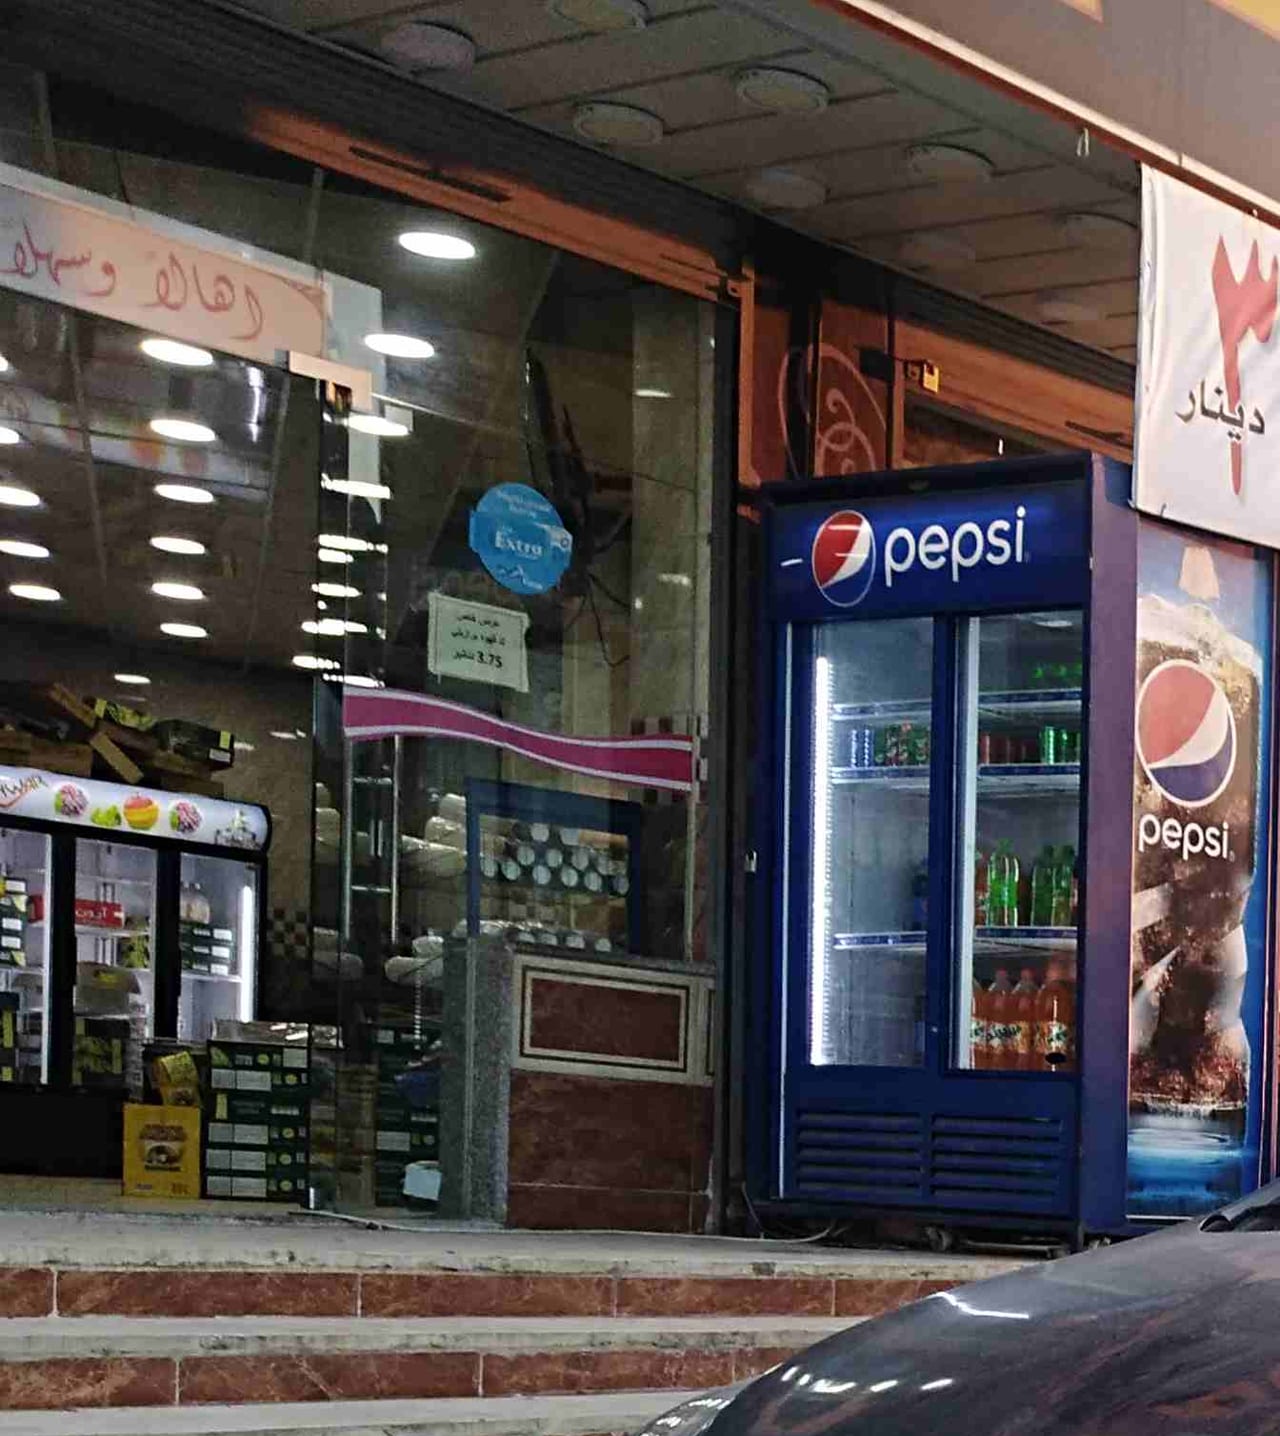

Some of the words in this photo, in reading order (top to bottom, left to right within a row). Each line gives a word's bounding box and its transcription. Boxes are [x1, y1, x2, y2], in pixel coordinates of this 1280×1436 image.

[1175, 380, 1266, 441] دينار
[884, 505, 1027, 588] pepsi
[1138, 813, 1230, 862] pepsi
